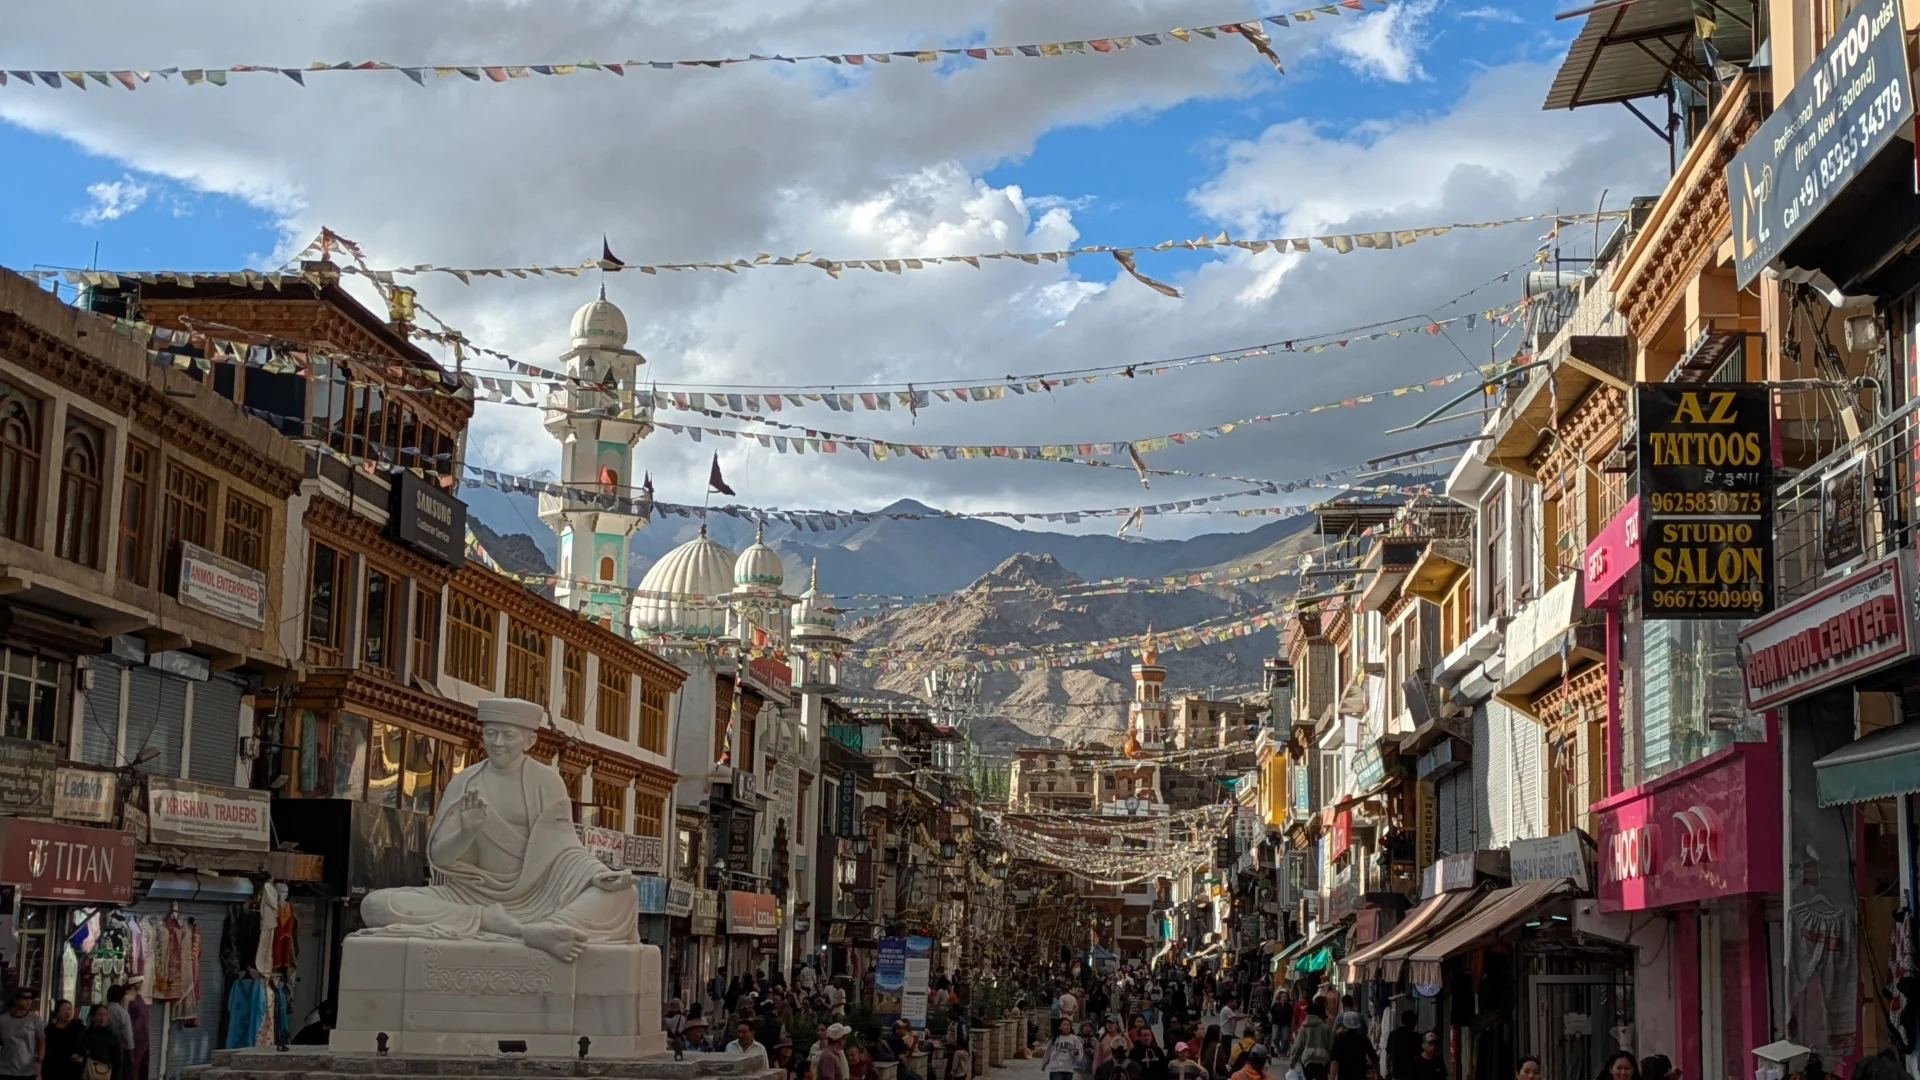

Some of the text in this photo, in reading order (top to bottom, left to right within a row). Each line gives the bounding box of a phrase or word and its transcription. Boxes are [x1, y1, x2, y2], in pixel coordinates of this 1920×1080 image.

[1774, 0, 1894, 158] Professional TATTOO Artist
[1795, 56, 1875, 171] (from New Zealand)
[1784, 78, 1901, 229] Call +91 85955 34378
[1671, 392, 1738, 424] AZ
[1650, 432, 1761, 466] TATTOOS
[416, 490, 452, 526] SAMSUNG
[1651, 492, 1762, 512] 9625830373
[1663, 523, 1752, 543] STUDIO
[1588, 549, 1603, 582] GIFTS
[1653, 547, 1764, 585] SALON
[190, 565, 216, 588] ANMOL
[216, 575, 258, 602] ENTERPRISES
[1653, 590, 1763, 608] 9667390999
[1778, 629, 1819, 678] WOOL
[1818, 596, 1890, 662] CENTER
[63, 775, 103, 800] Ladakh
[166, 797, 210, 819] KRISHNA
[214, 804, 257, 824] TRADERS
[54, 841, 115, 883] TITAN
[728, 853, 748, 861] COFFEE
